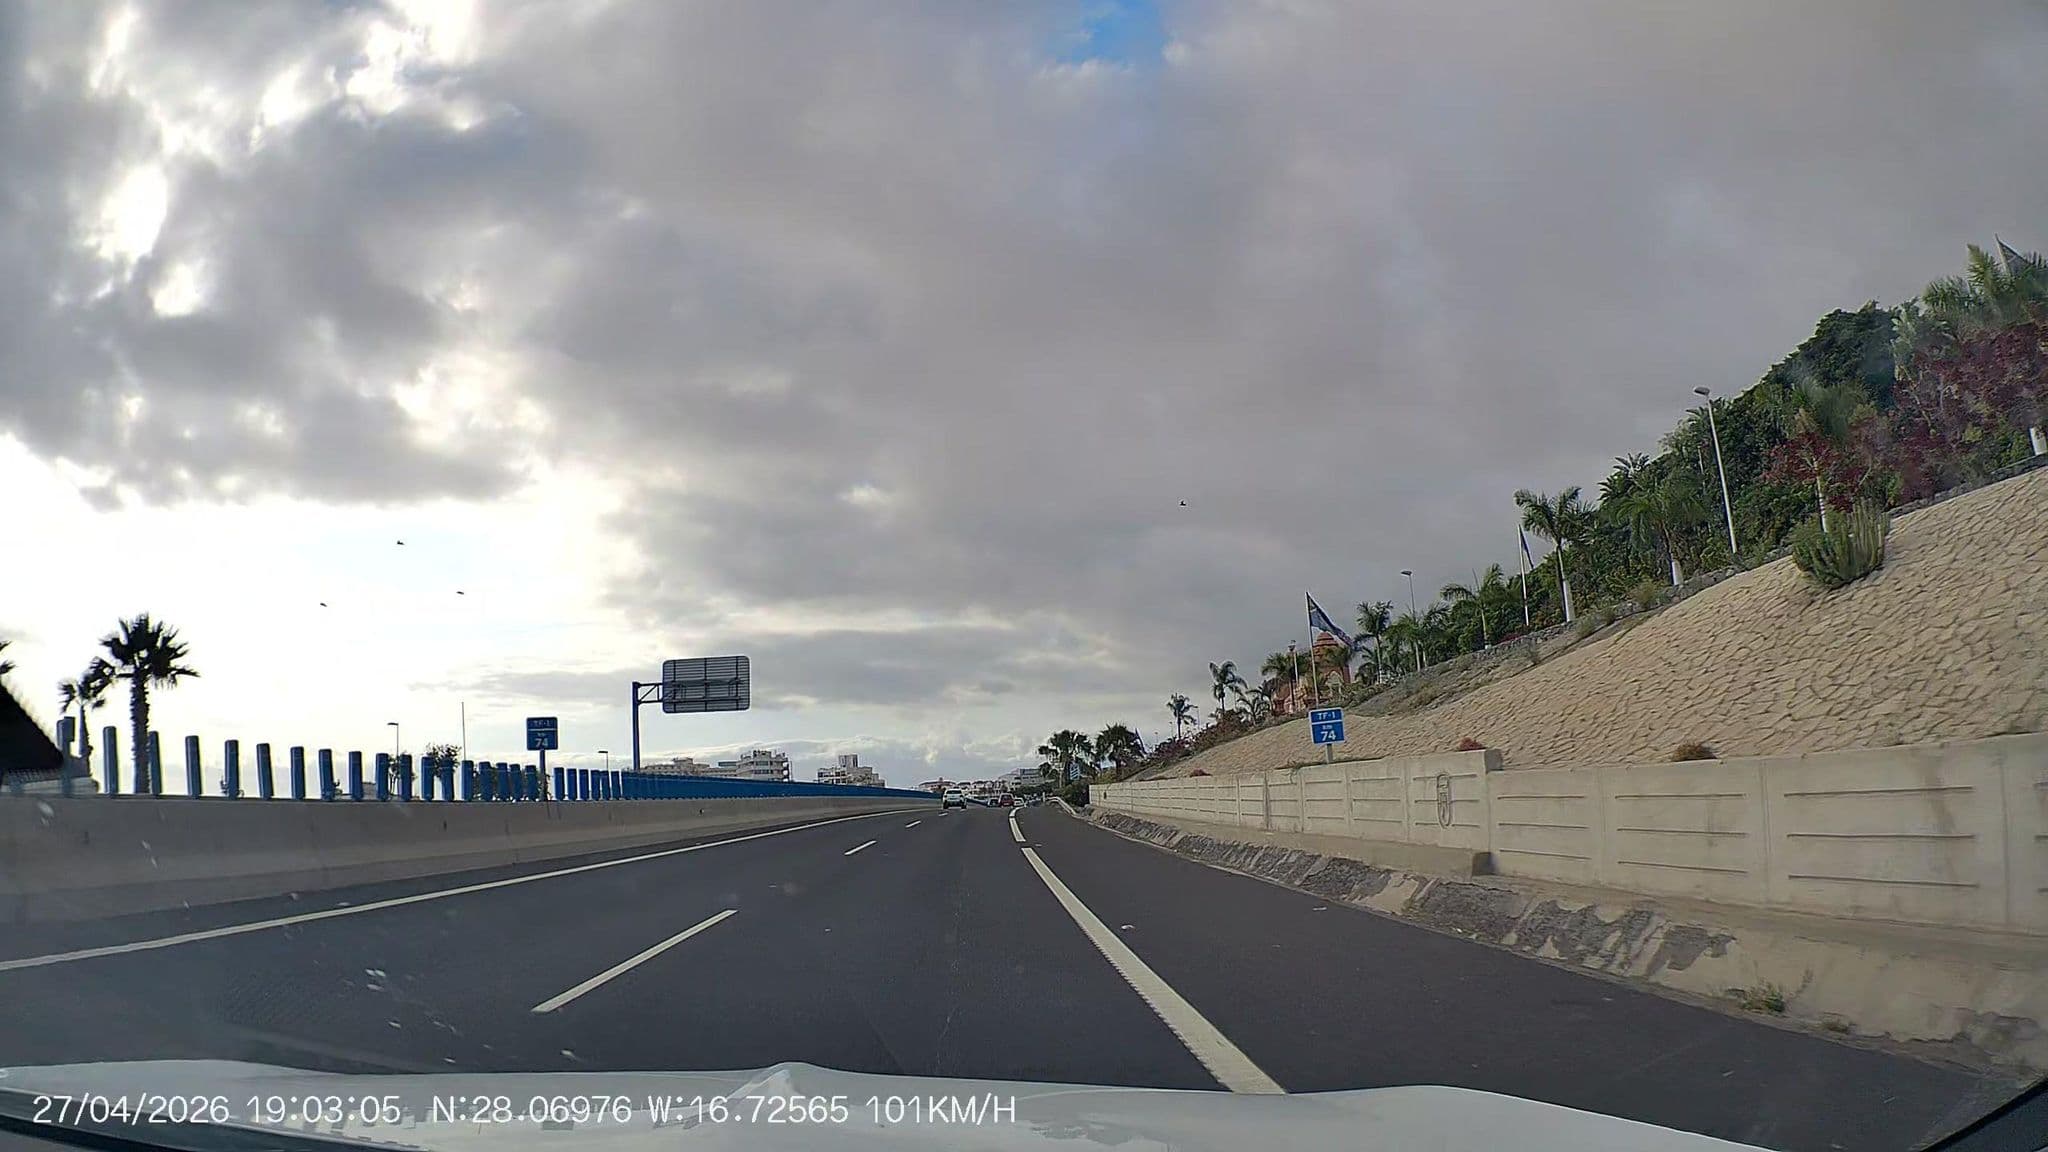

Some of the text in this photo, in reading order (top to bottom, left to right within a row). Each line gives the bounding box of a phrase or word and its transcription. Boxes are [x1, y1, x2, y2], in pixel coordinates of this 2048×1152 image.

[1317, 711, 1336, 720] TF-1
[1320, 730, 1336, 741] 74
[534, 738, 548, 748] 74
